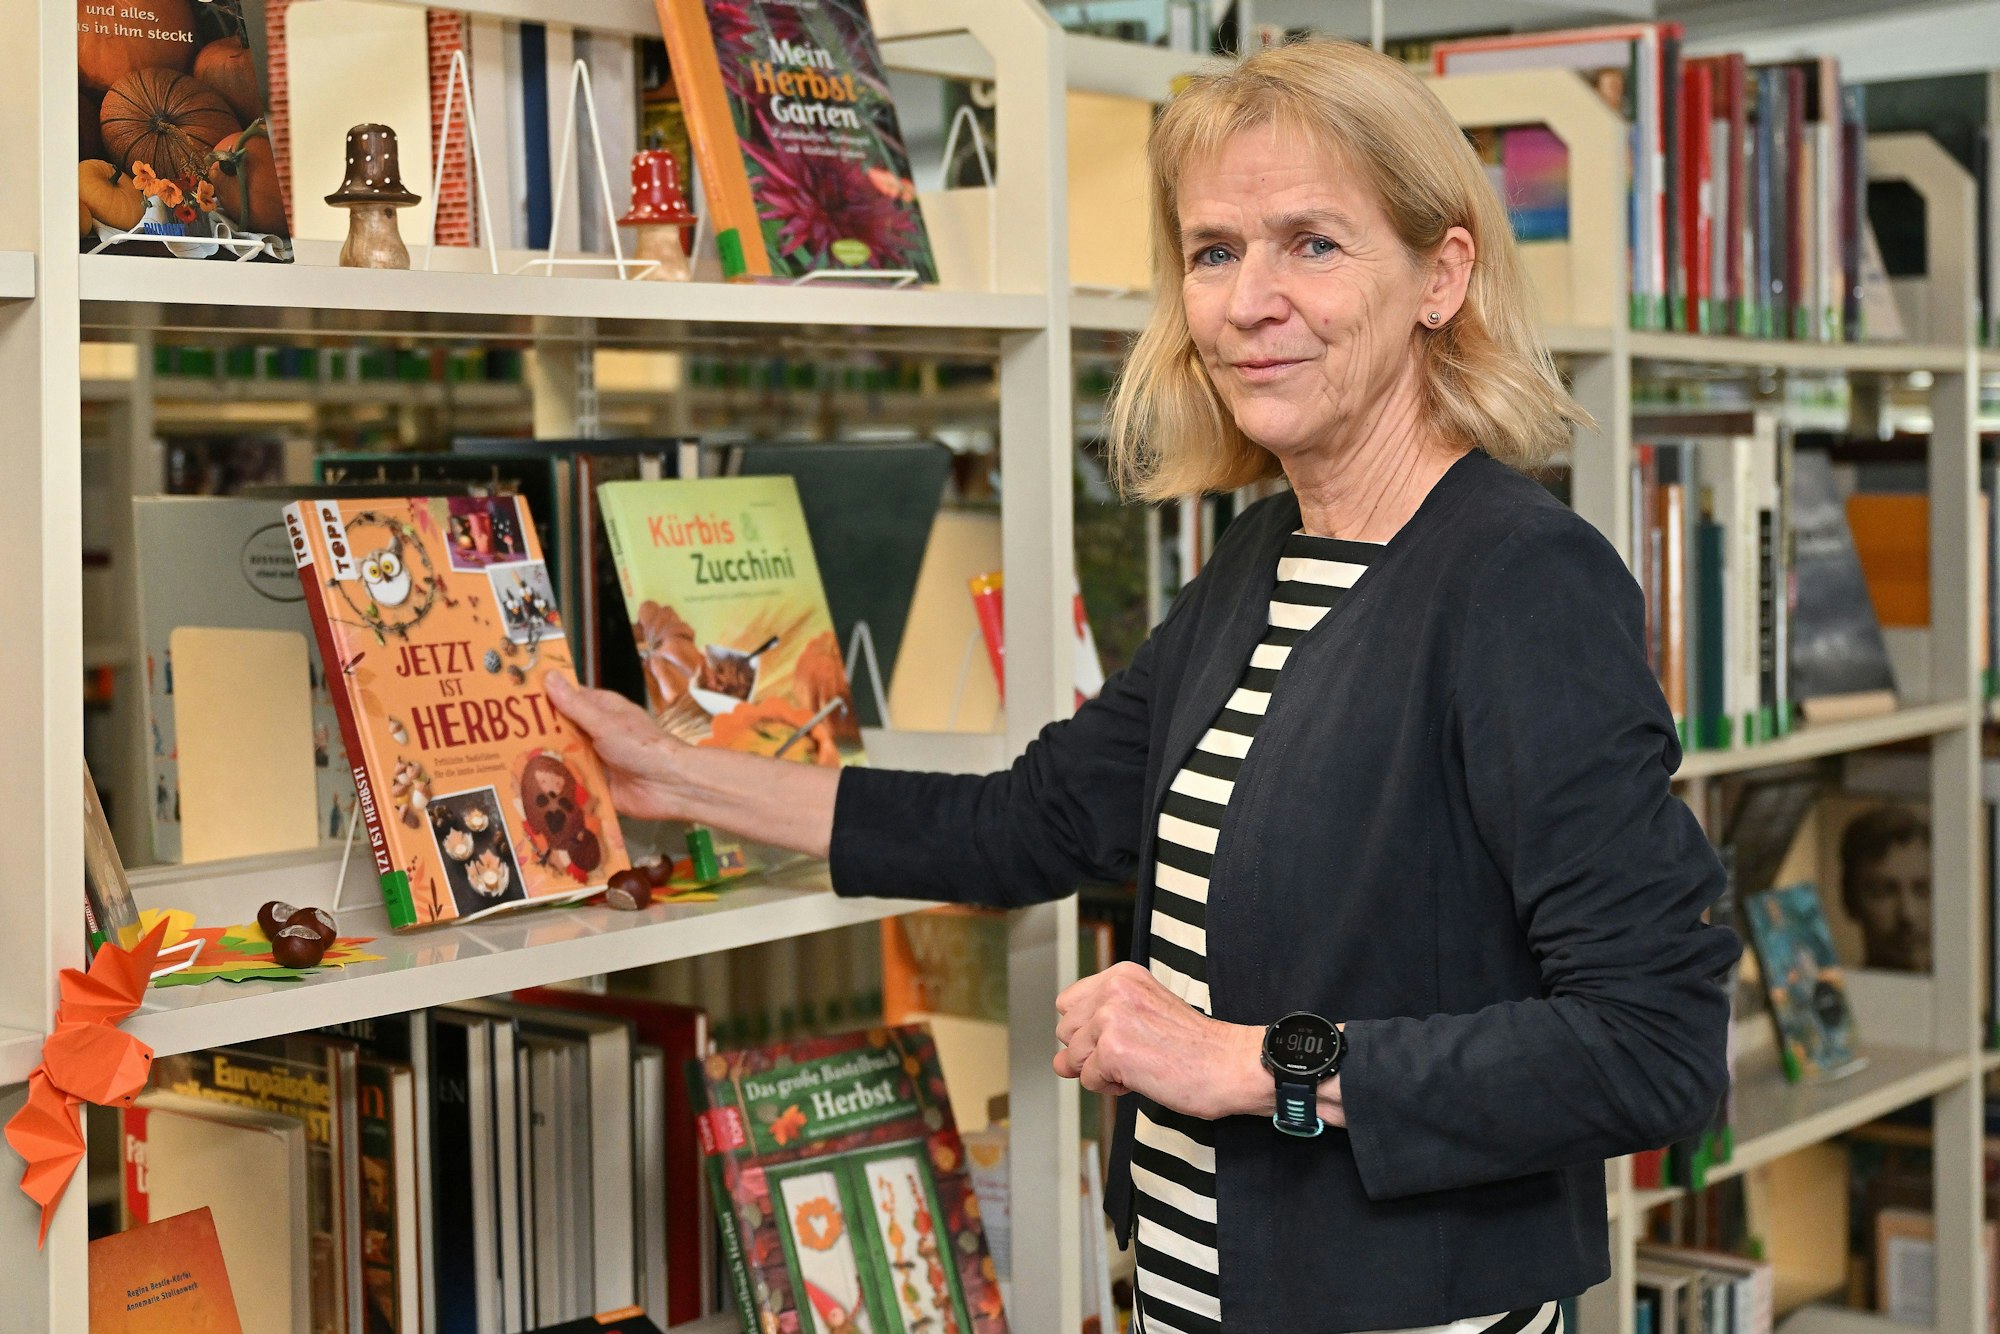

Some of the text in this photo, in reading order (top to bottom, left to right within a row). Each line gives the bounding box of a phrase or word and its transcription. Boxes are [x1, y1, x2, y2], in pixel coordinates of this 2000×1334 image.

[86, 5, 160, 23] und alles,
[94, 21, 110, 35] in
[114, 23, 144, 38] ihm
[147, 29, 194, 43] steckt
[768, 36, 835, 70] Mein
[769, 95, 860, 129] Garten
[286, 513, 306, 563] TOPP
[321, 506, 351, 575] TOPP
[647, 511, 760, 548] Kürbis &
[690, 547, 796, 586] Zucchini
[396, 640, 475, 678] JETZT
[438, 678, 464, 698] IST
[411, 692, 562, 750] HERBST!
[353, 765, 377, 824] HERBST!
[368, 826, 384, 848] IST
[745, 1081, 777, 1101] Das
[776, 1067, 821, 1099] große
[810, 1078, 897, 1121] Herbst
[126, 1285, 149, 1298] Regina
[126, 1281, 199, 1312] Annemarie Stollenwerk
